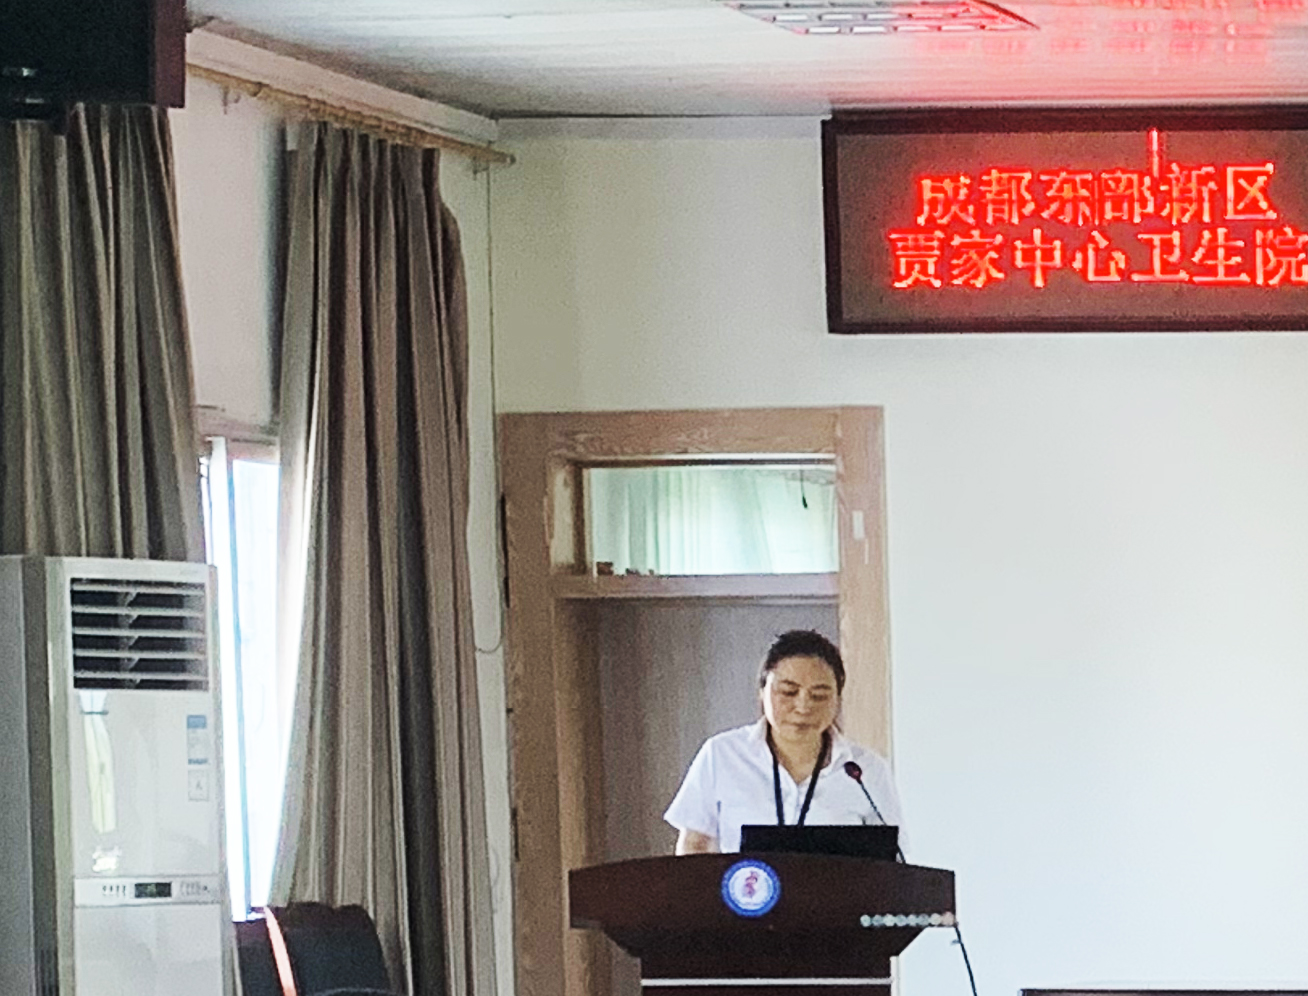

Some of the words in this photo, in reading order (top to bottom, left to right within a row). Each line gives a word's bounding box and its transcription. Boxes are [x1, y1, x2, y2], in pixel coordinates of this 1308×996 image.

[916, 162, 1280, 228] 成都东部新区
